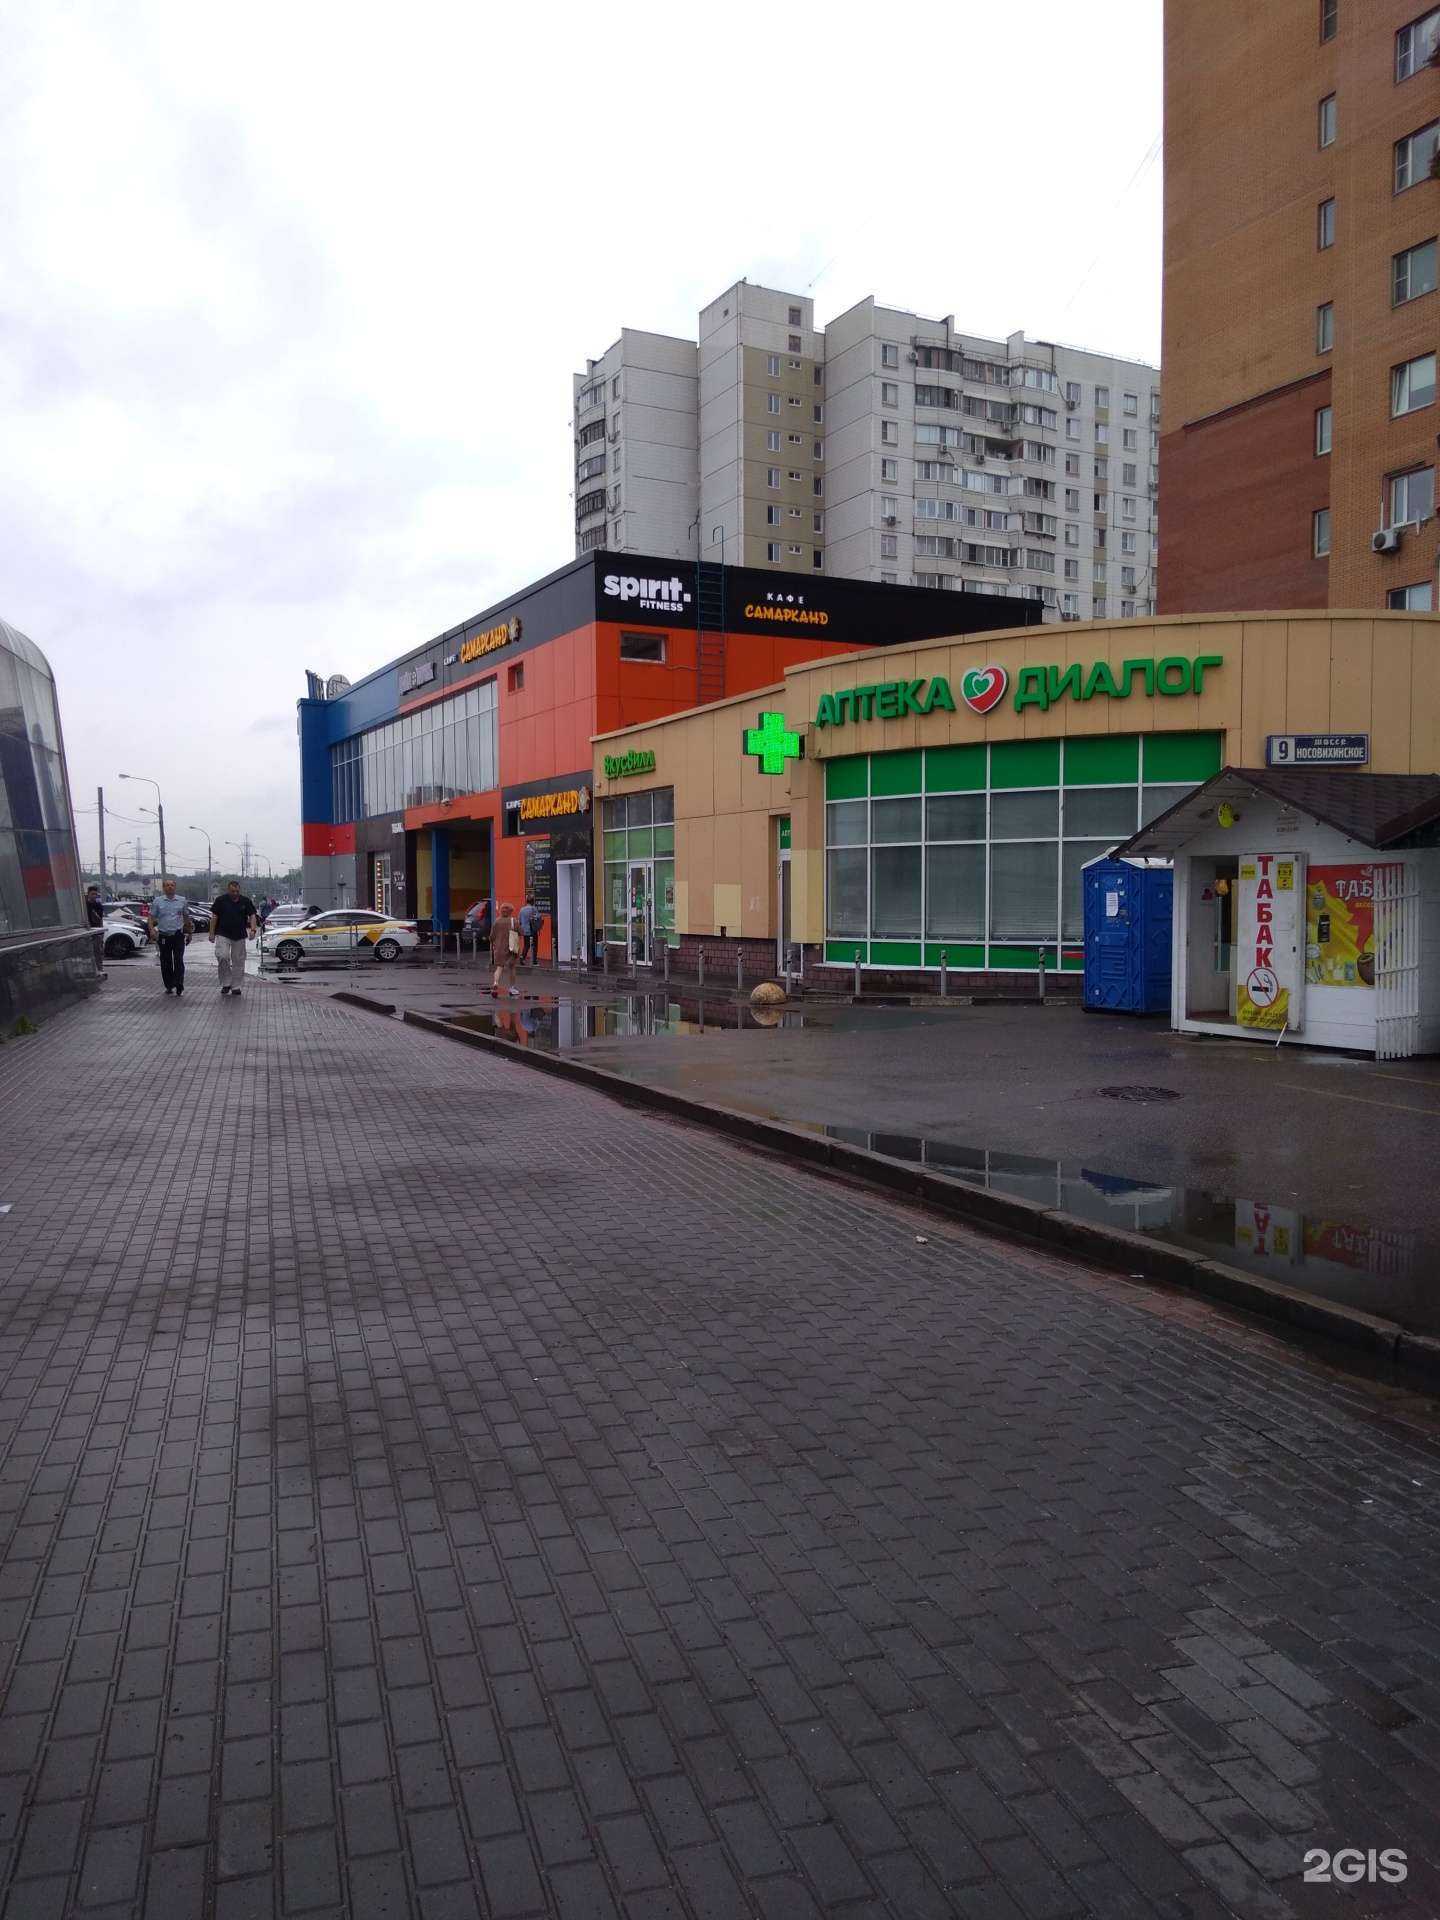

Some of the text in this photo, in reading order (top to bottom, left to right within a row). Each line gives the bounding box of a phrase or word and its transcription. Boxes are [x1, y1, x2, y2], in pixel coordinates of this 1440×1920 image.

[640, 600, 684, 612] FITNESS
[766, 592, 805, 604] КАФЕ
[744, 604, 829, 625] САМАРКАНД
[460, 623, 509, 664] САМАРКАНД
[814, 655, 1224, 728] АПТЕКА ДИАЛОГ
[1278, 740, 1289, 760] 9
[1296, 746, 1365, 759] НОСОВИХИНСКОЕ
[520, 790, 579, 820] САМАРКАНД
[1256, 856, 1274, 968] ТАБАК
